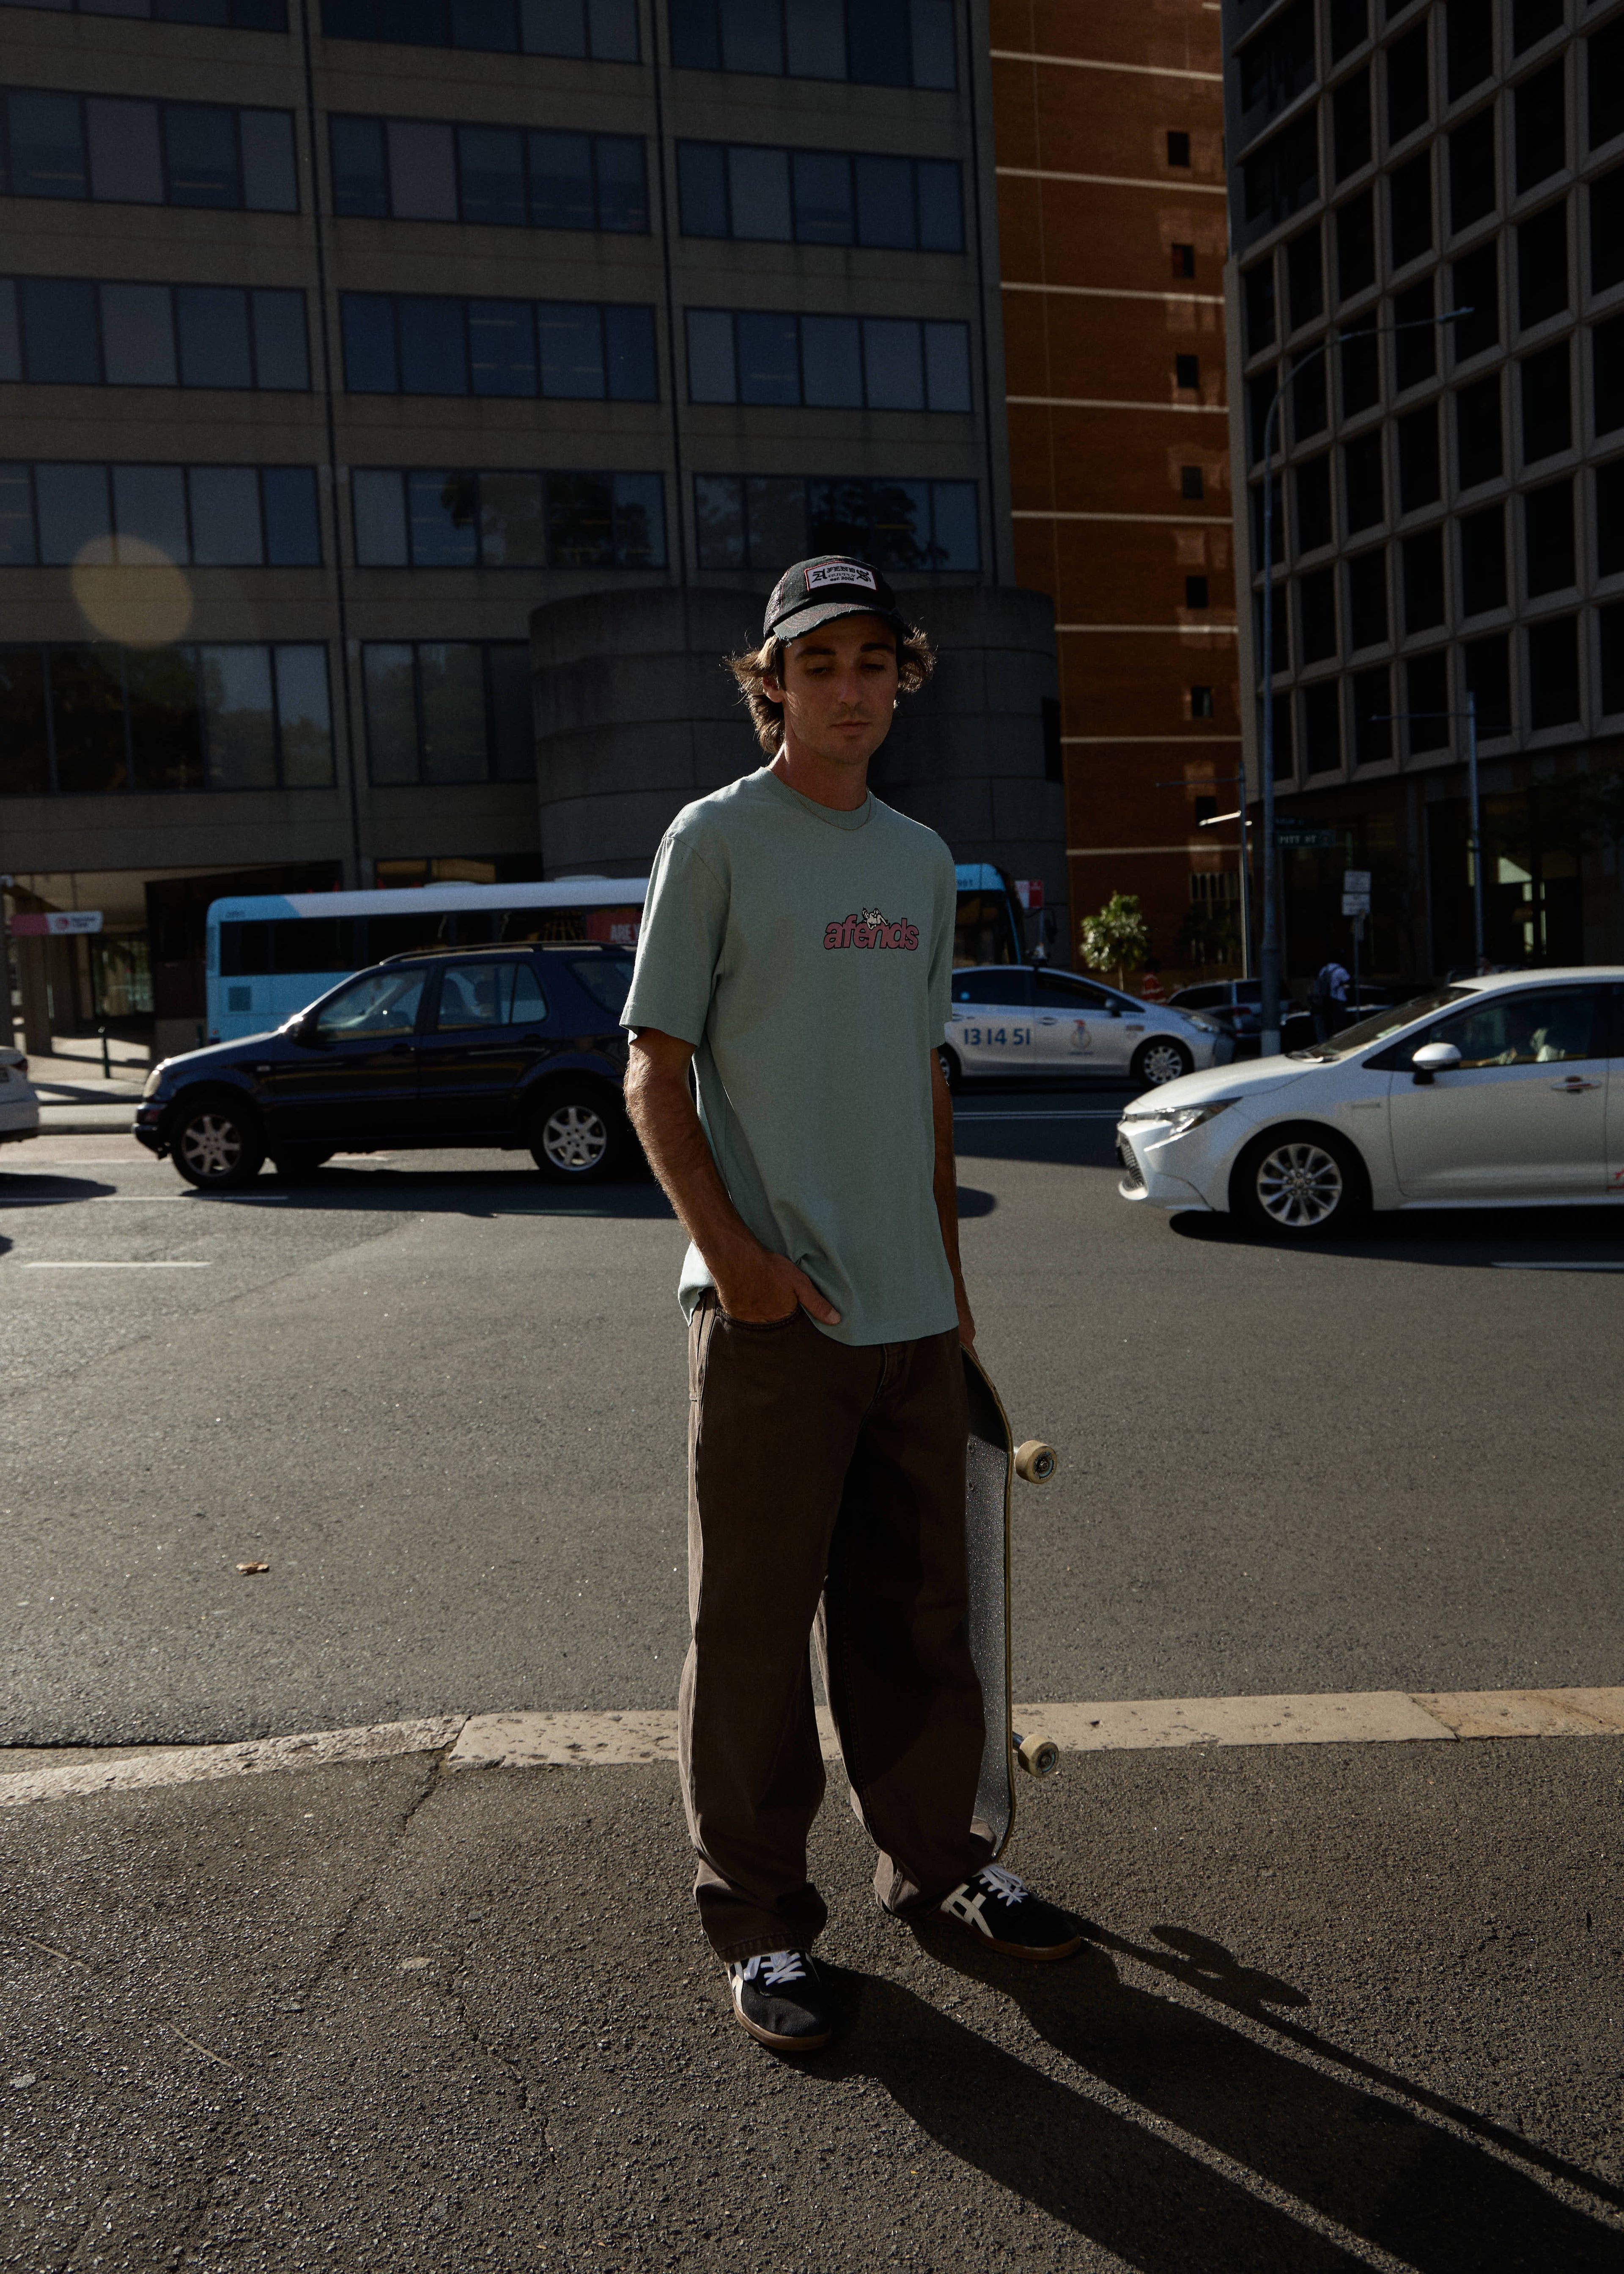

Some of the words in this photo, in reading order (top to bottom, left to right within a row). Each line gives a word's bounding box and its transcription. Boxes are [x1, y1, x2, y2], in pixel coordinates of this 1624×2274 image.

[823, 914, 919, 950] afends
[965, 1028, 981, 1045] 13
[988, 1028, 1007, 1044] 14
[1013, 1028, 1030, 1045] 51
